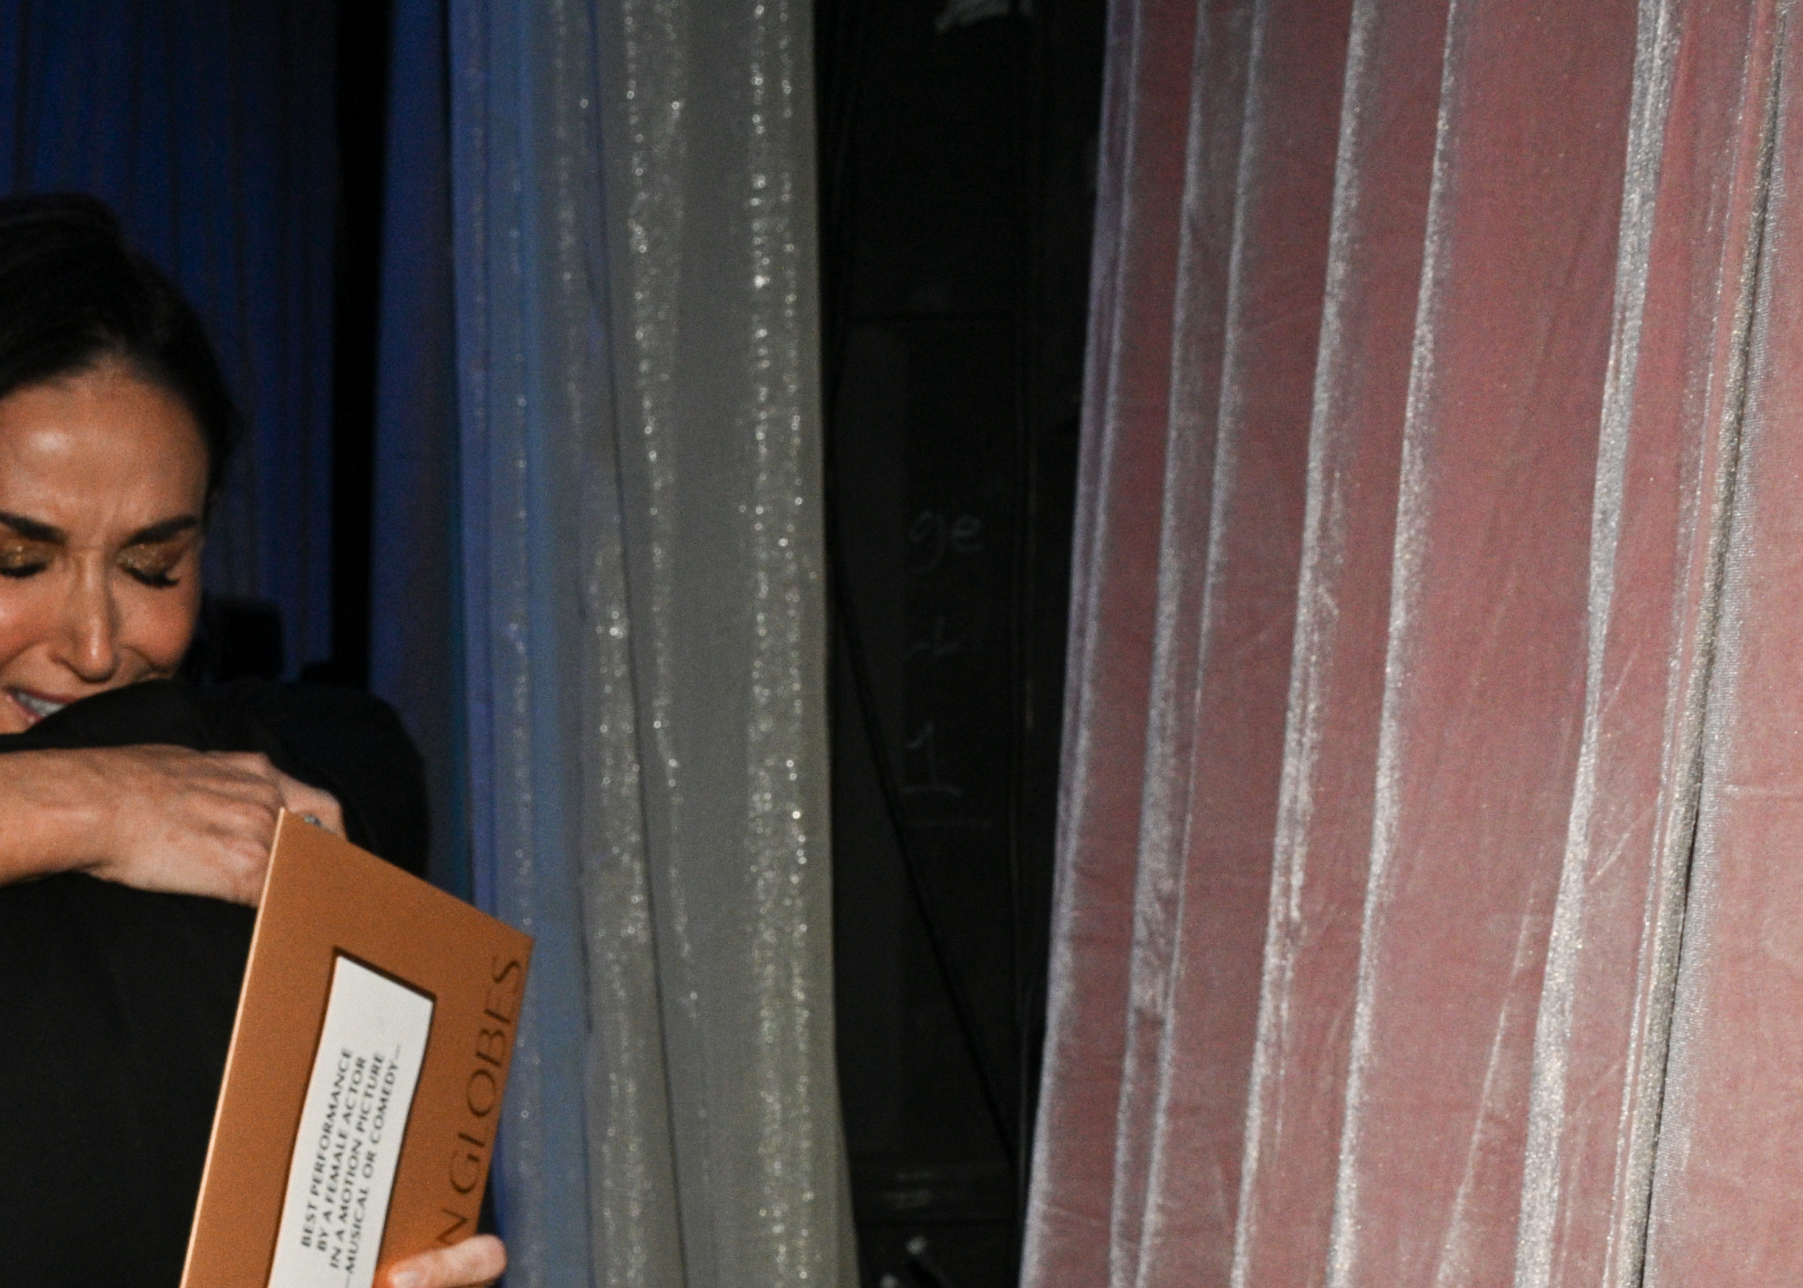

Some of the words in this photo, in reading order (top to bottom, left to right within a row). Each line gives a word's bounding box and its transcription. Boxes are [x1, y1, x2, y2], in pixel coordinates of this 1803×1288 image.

[342, 1057, 366, 1125] ACTOR
[355, 1051, 385, 1134] PICTURE
[449, 954, 521, 1194] GLOBES
[300, 1202, 317, 1248] BEST
[310, 1046, 353, 1196] PERFORMANCE
[325, 1129, 348, 1203] FEMALE
[339, 1138, 362, 1223] MOTION
[362, 1150, 377, 1179] OR
[317, 1228, 329, 1252] BY
[323, 1211, 332, 1224] A
[335, 1229, 345, 1243] A
[329, 1246, 342, 1269] IN
